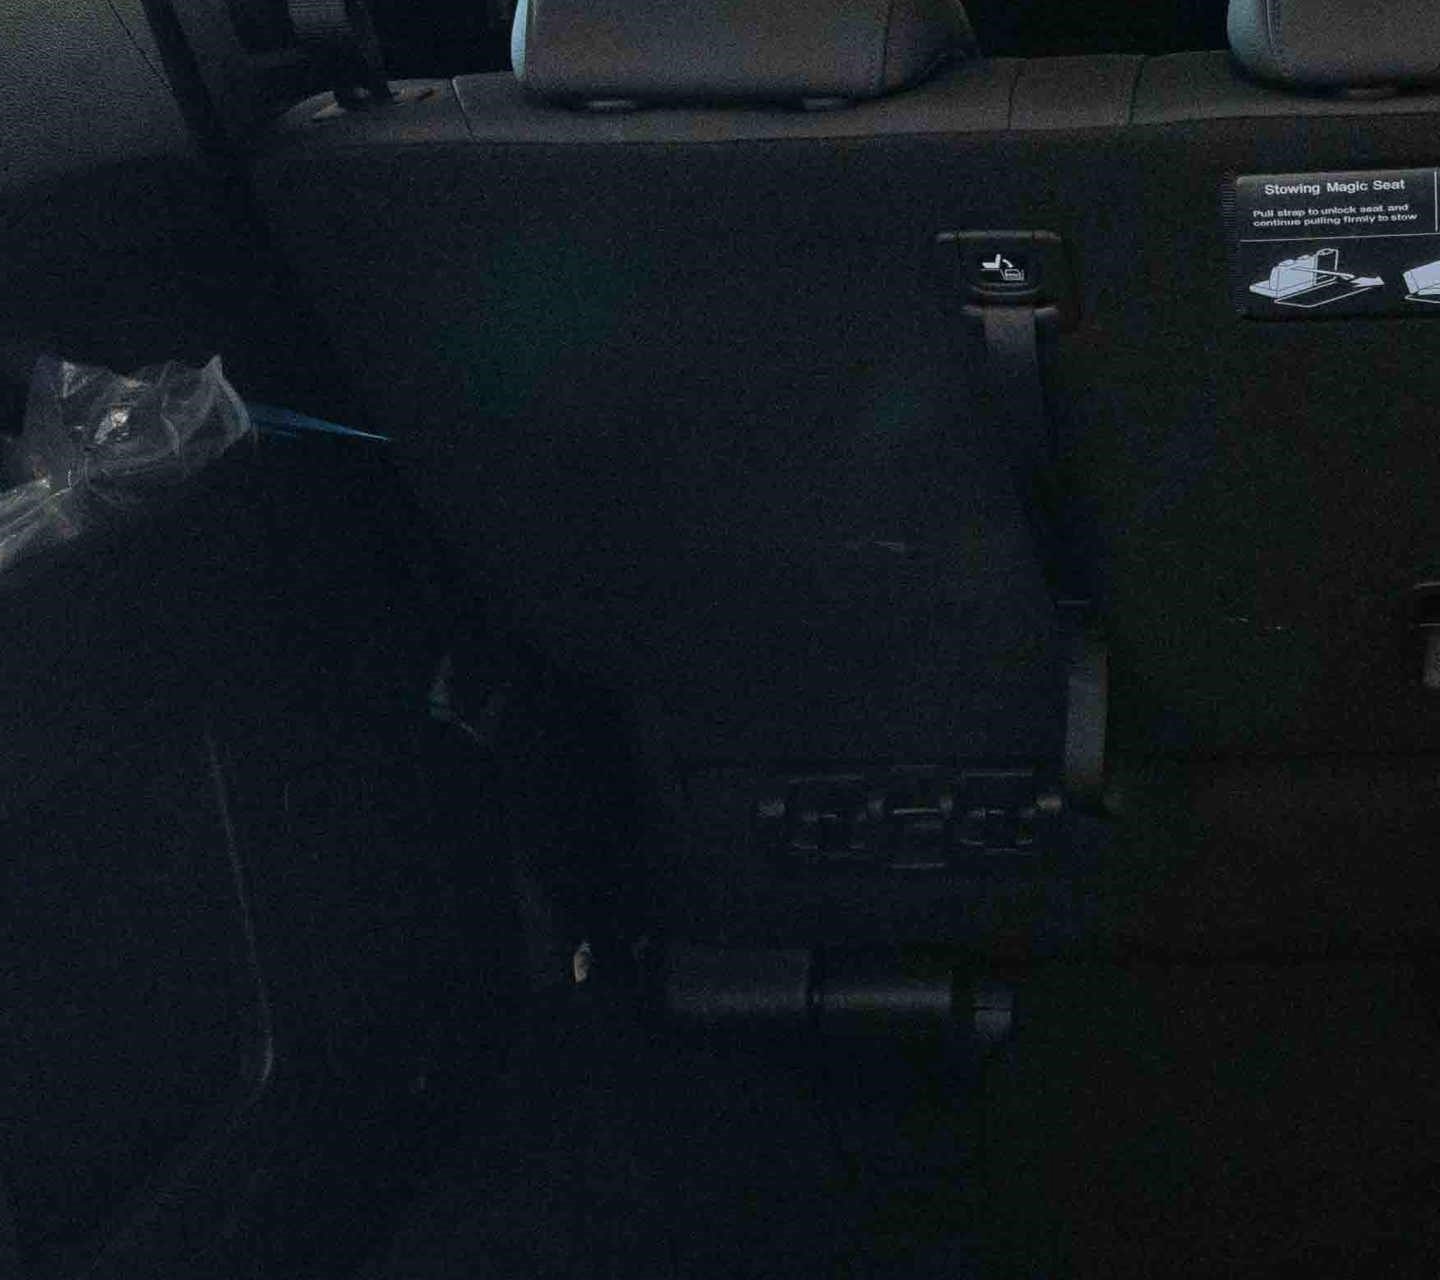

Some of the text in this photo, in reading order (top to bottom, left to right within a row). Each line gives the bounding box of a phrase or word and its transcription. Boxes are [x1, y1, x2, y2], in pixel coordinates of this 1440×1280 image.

[1264, 179, 1406, 195] Stowing Magic Seat
[1253, 210, 1274, 218] Pull
[1277, 209, 1306, 219] strap
[1308, 208, 1319, 216] to
[1321, 206, 1357, 215] unlock
[1388, 203, 1409, 211] and
[1253, 213, 1418, 227] continue pulling firmly to stow
